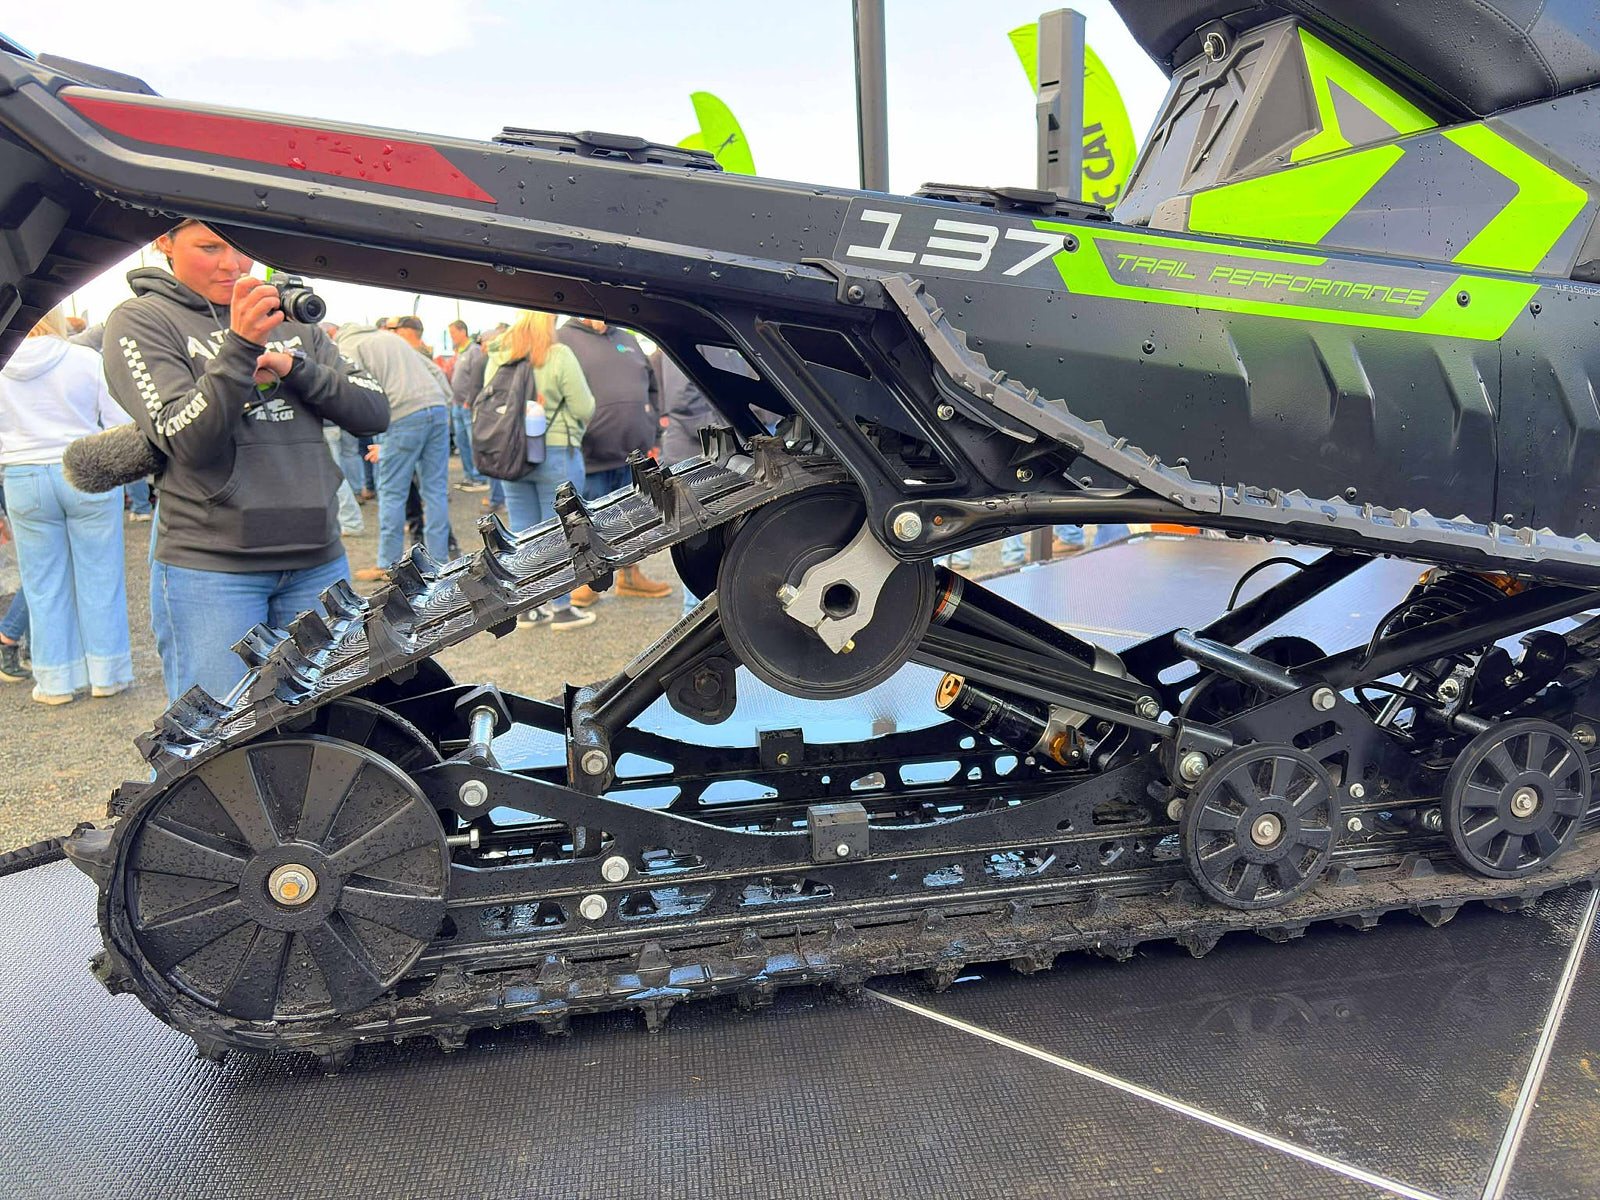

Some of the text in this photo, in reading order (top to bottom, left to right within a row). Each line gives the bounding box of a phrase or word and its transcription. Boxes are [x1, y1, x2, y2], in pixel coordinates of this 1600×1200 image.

[846, 209, 1065, 277] 137
[1116, 253, 1430, 306] TRAIL PERFORMANCE
